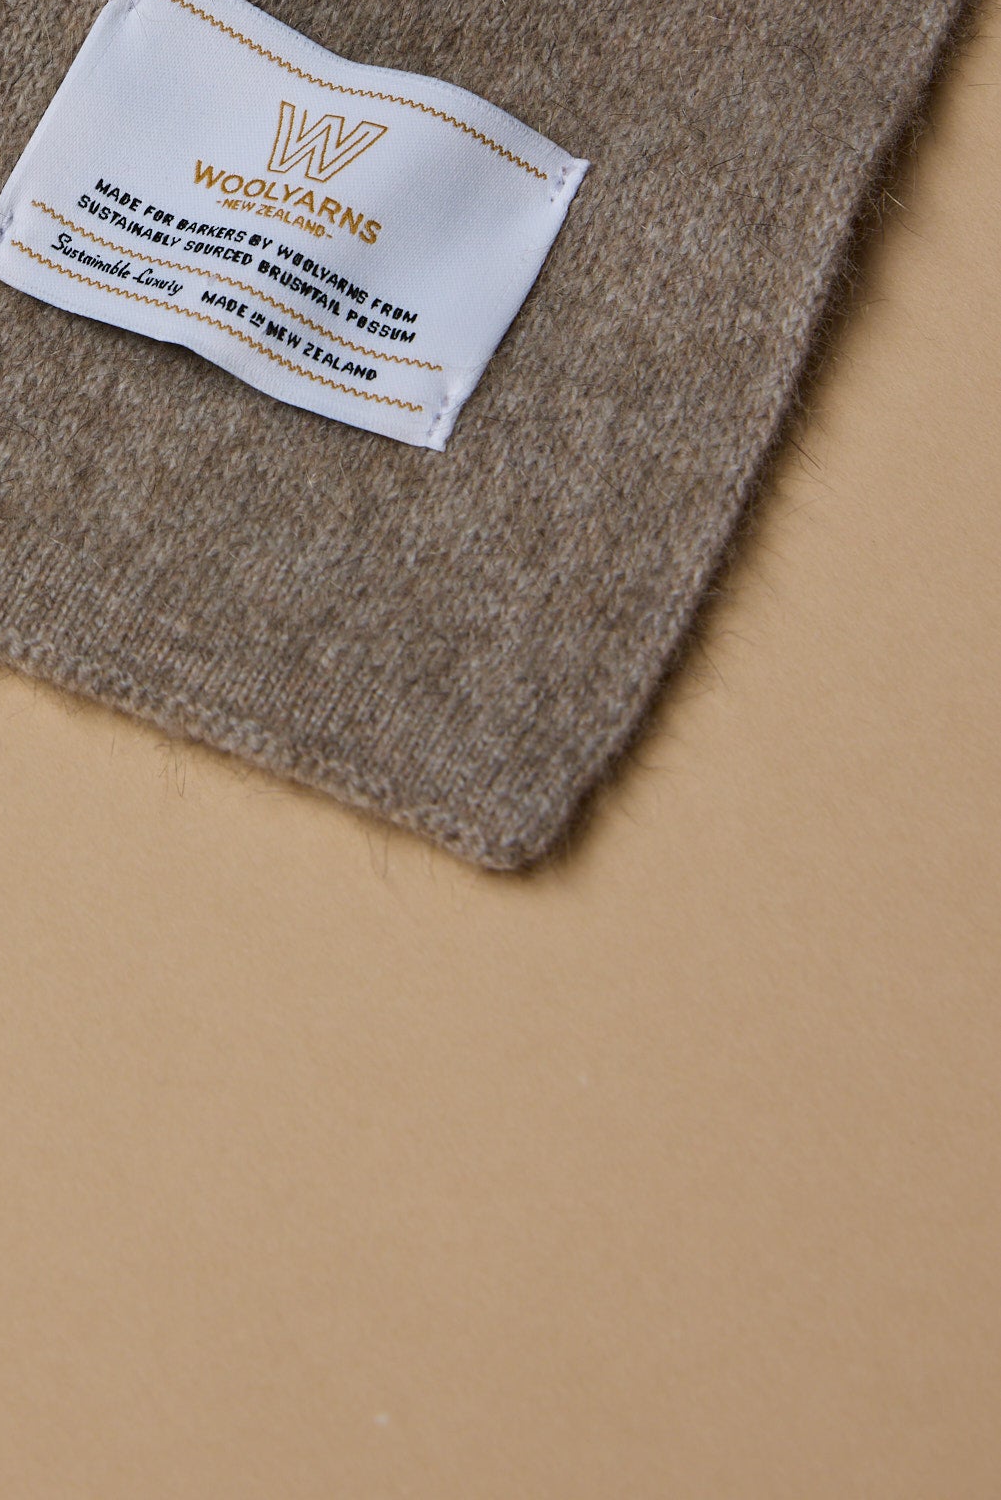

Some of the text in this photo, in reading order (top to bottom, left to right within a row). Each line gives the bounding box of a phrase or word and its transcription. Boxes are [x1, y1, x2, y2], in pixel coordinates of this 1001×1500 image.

[194, 159, 382, 245] WOOLYARNS
[50, 232, 131, 279] Sustainable
[77, 194, 416, 344] SUSTAINABLY SOURCED BRUSHTAIL POSSUM
[94, 178, 418, 324] MADE FOR BARKERS BY WOOLYARNS FROM
[201, 290, 378, 381] MADE IN NEW ZEALAND
